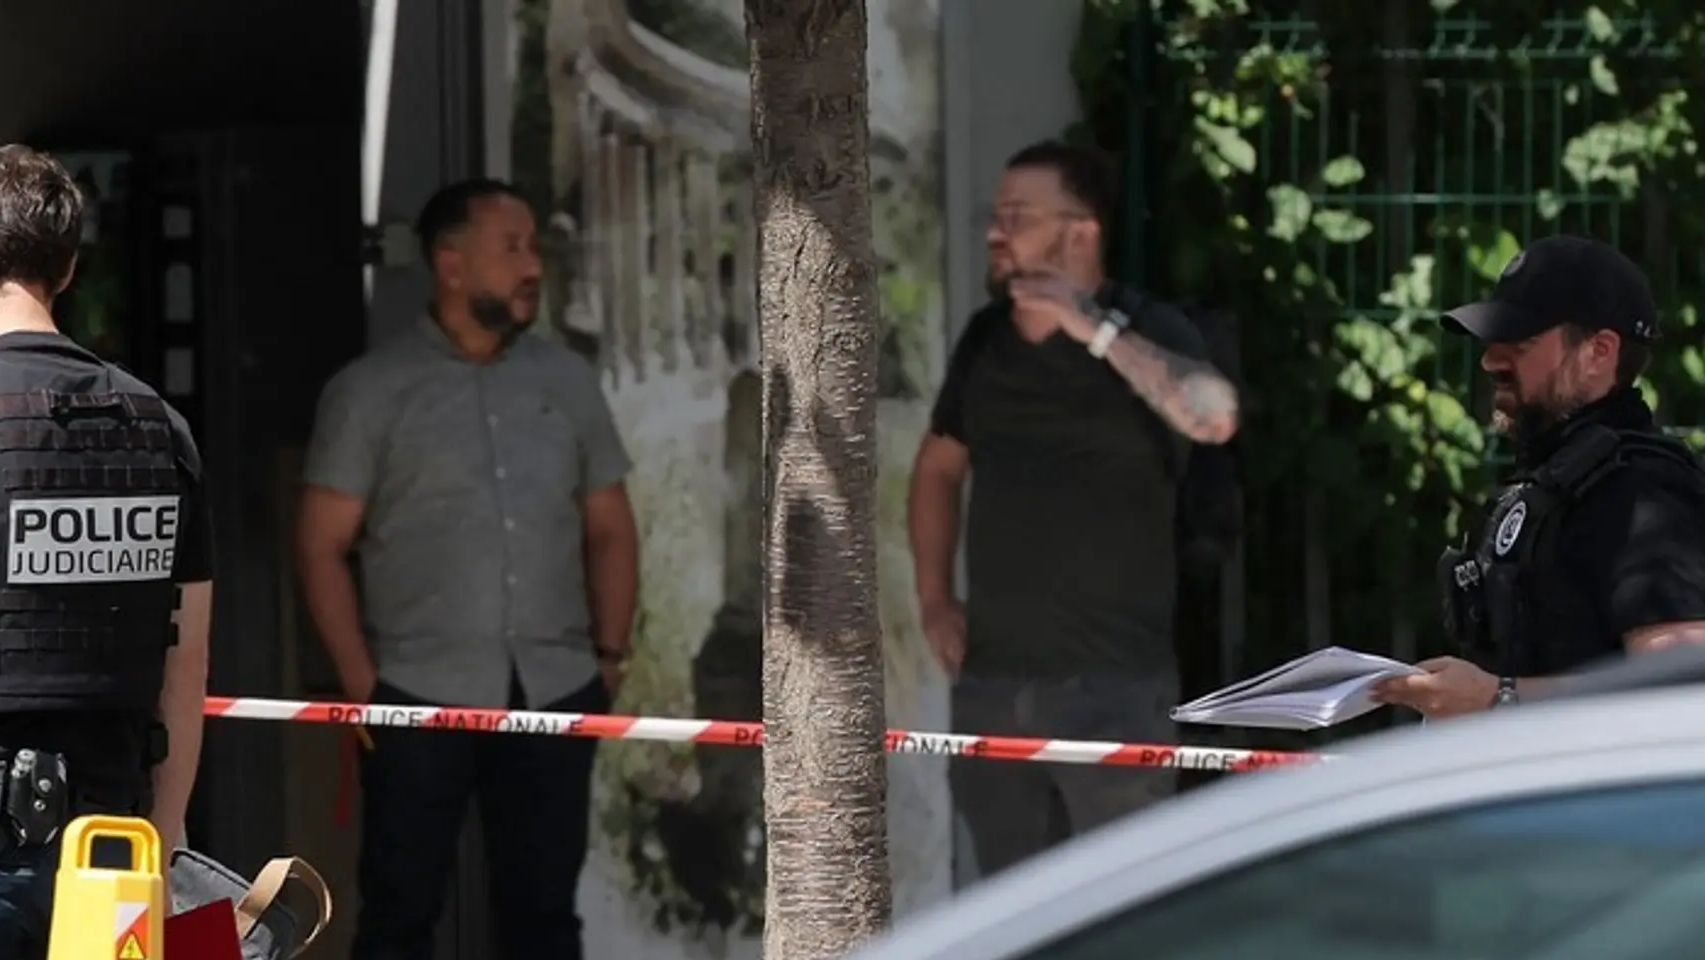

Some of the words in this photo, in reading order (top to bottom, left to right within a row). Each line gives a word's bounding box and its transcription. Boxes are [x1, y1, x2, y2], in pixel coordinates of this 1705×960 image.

[14, 505, 177, 544] POLICE
[12, 547, 174, 576] JUDICIAIRE
[328, 705, 423, 727] POLICE
[433, 711, 584, 734] NATIONALE
[1140, 748, 1237, 771] POLICE
